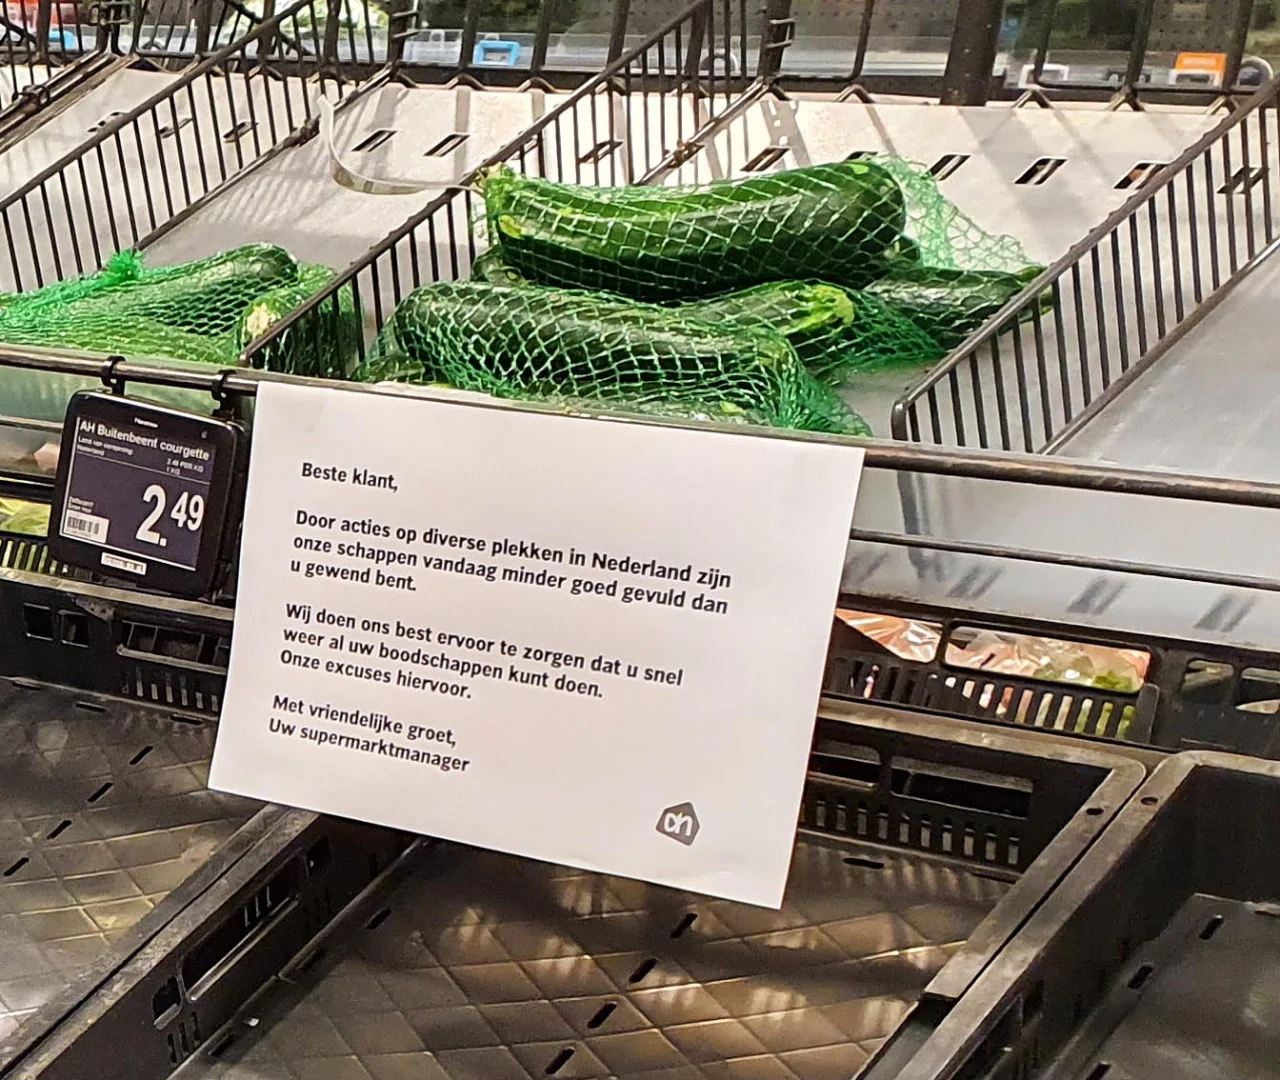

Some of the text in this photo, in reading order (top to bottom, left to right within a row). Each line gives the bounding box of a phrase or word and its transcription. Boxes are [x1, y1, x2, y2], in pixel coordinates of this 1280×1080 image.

[80, 420, 96, 434] AH
[159, 441, 210, 461] courgette
[301, 462, 398, 493] Beste klant,
[134, 483, 206, 548] 2.49
[290, 559, 417, 592] u gewend bent.
[293, 536, 729, 615] onze schappen vandaag minder goed gevuld dan
[295, 509, 732, 591] Door acties op diverse plekken in Nederland zijn
[283, 628, 603, 698] weer al uw boodschappen kunt doen.
[285, 602, 684, 686] Wij doen ons best ervoor te zorgen dat u snel
[280, 649, 472, 699] Onze excuses hiervoor.
[268, 717, 471, 772] Uw supermarktmanager
[272, 694, 456, 749] Met vriendelijke groet,
